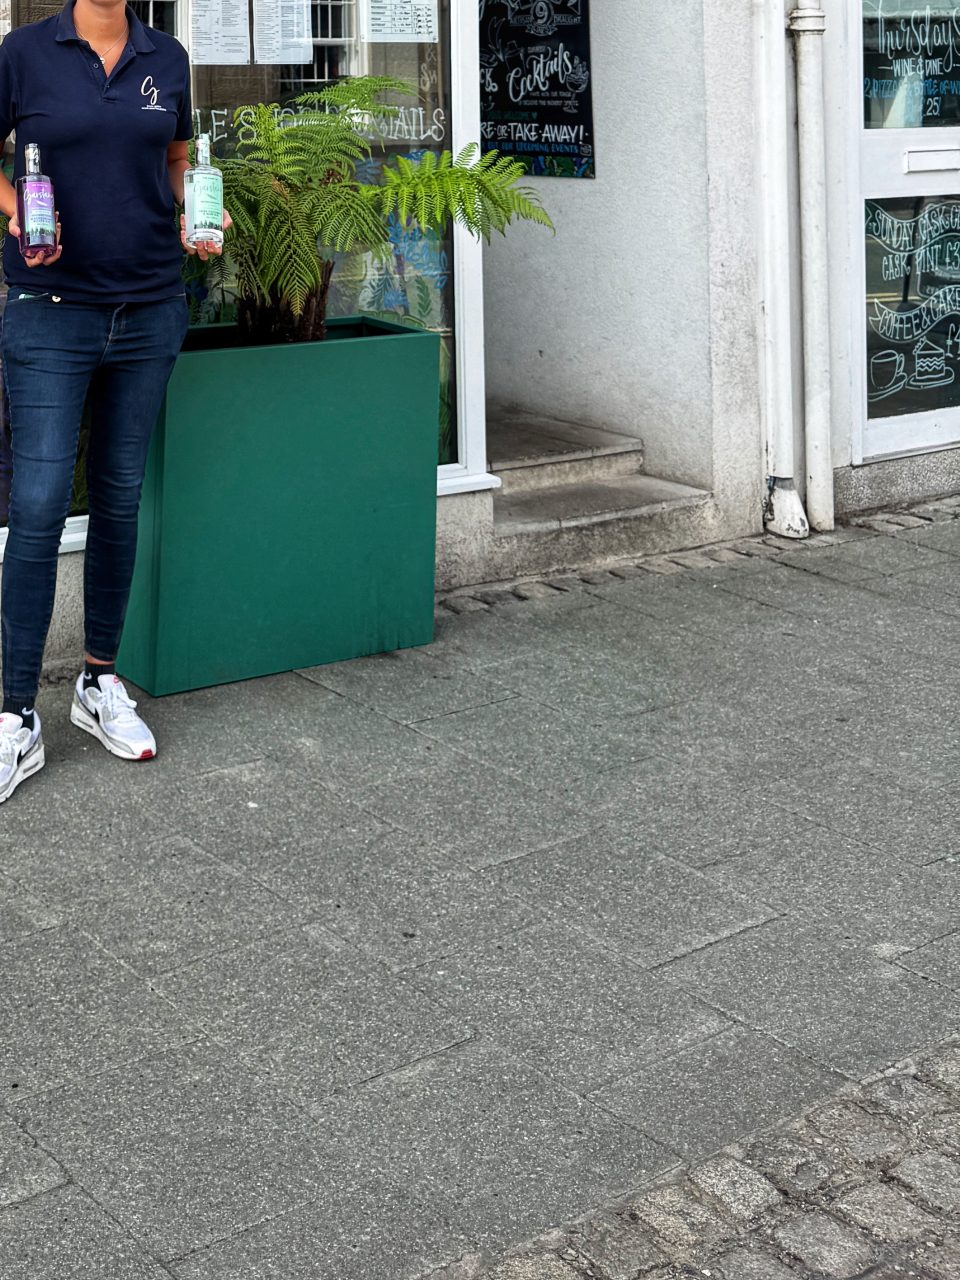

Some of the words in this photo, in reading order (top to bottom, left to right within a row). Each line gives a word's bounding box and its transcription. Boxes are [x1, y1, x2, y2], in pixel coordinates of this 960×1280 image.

[535, 1, 549, 24] 9
[507, 42, 572, 102] Cocktails
[892, 58, 916, 76] WINE
[508, 122, 539, 141] TAKE
[551, 144, 579, 154] EVENTS
[872, 208, 915, 251] SUNDAY
[918, 203, 951, 246] CASK
[882, 253, 910, 282] CASK
[915, 244, 942, 275] PINT
[879, 310, 923, 340] COFFEE
[921, 305, 932, 327] &
